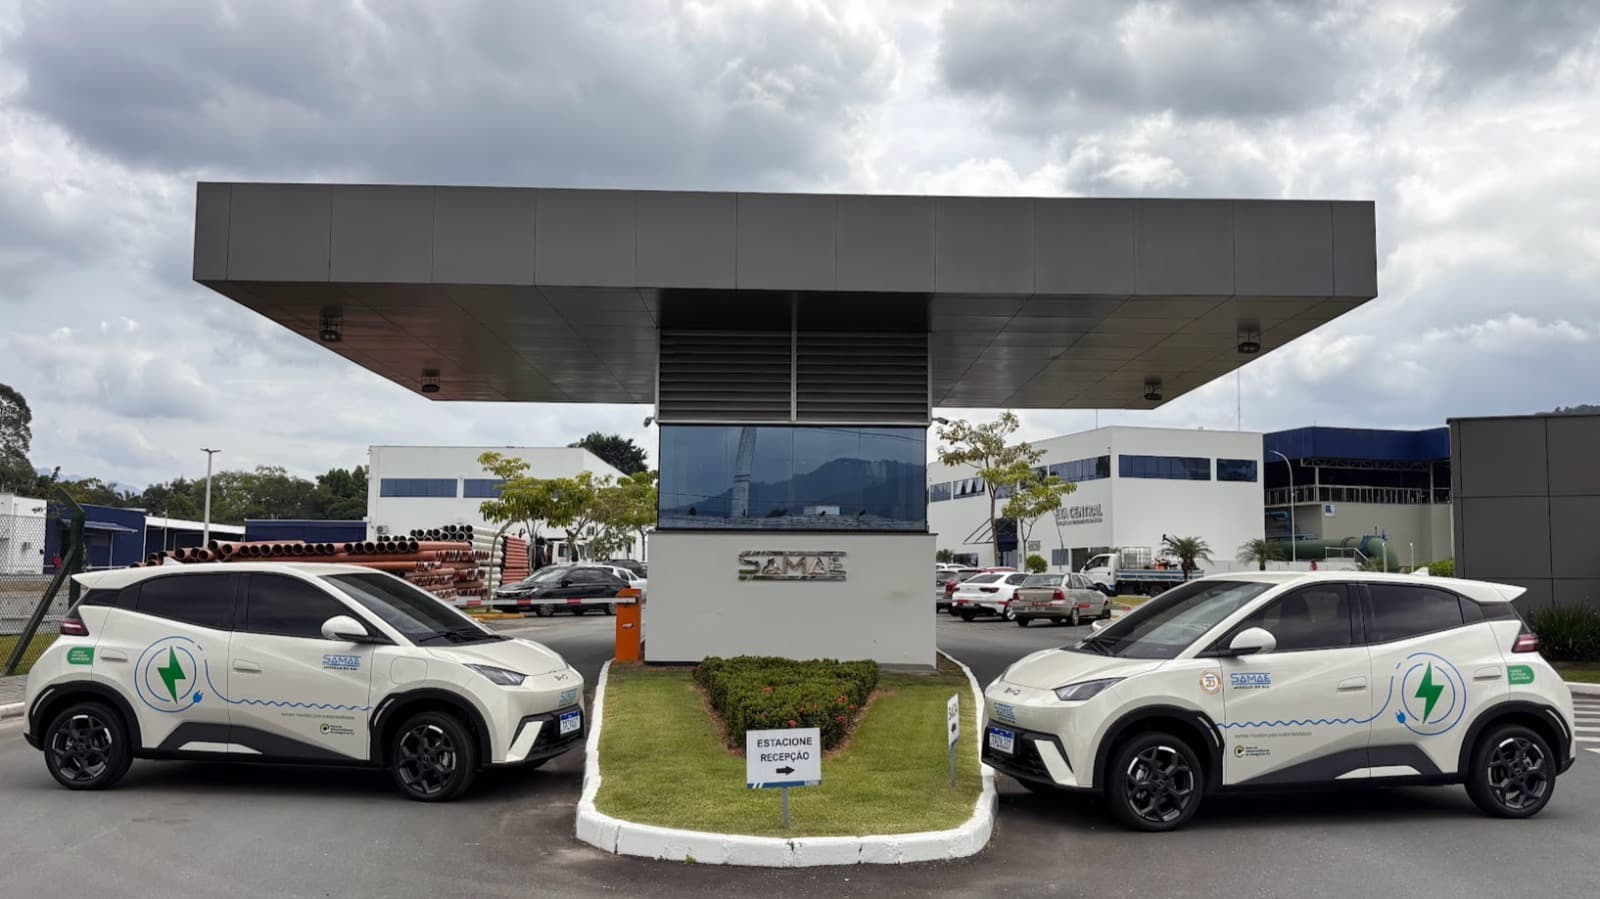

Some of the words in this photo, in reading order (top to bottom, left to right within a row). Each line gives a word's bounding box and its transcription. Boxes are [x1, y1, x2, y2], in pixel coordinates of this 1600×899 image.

[1070, 504, 1103, 519] CENTRAL
[738, 550, 847, 581] SAMAE
[322, 654, 361, 668] SAMAE
[1231, 672, 1272, 685] SAMAE
[757, 737, 813, 748] ESTACIONE
[760, 750, 810, 762] RECEPÇÃO
